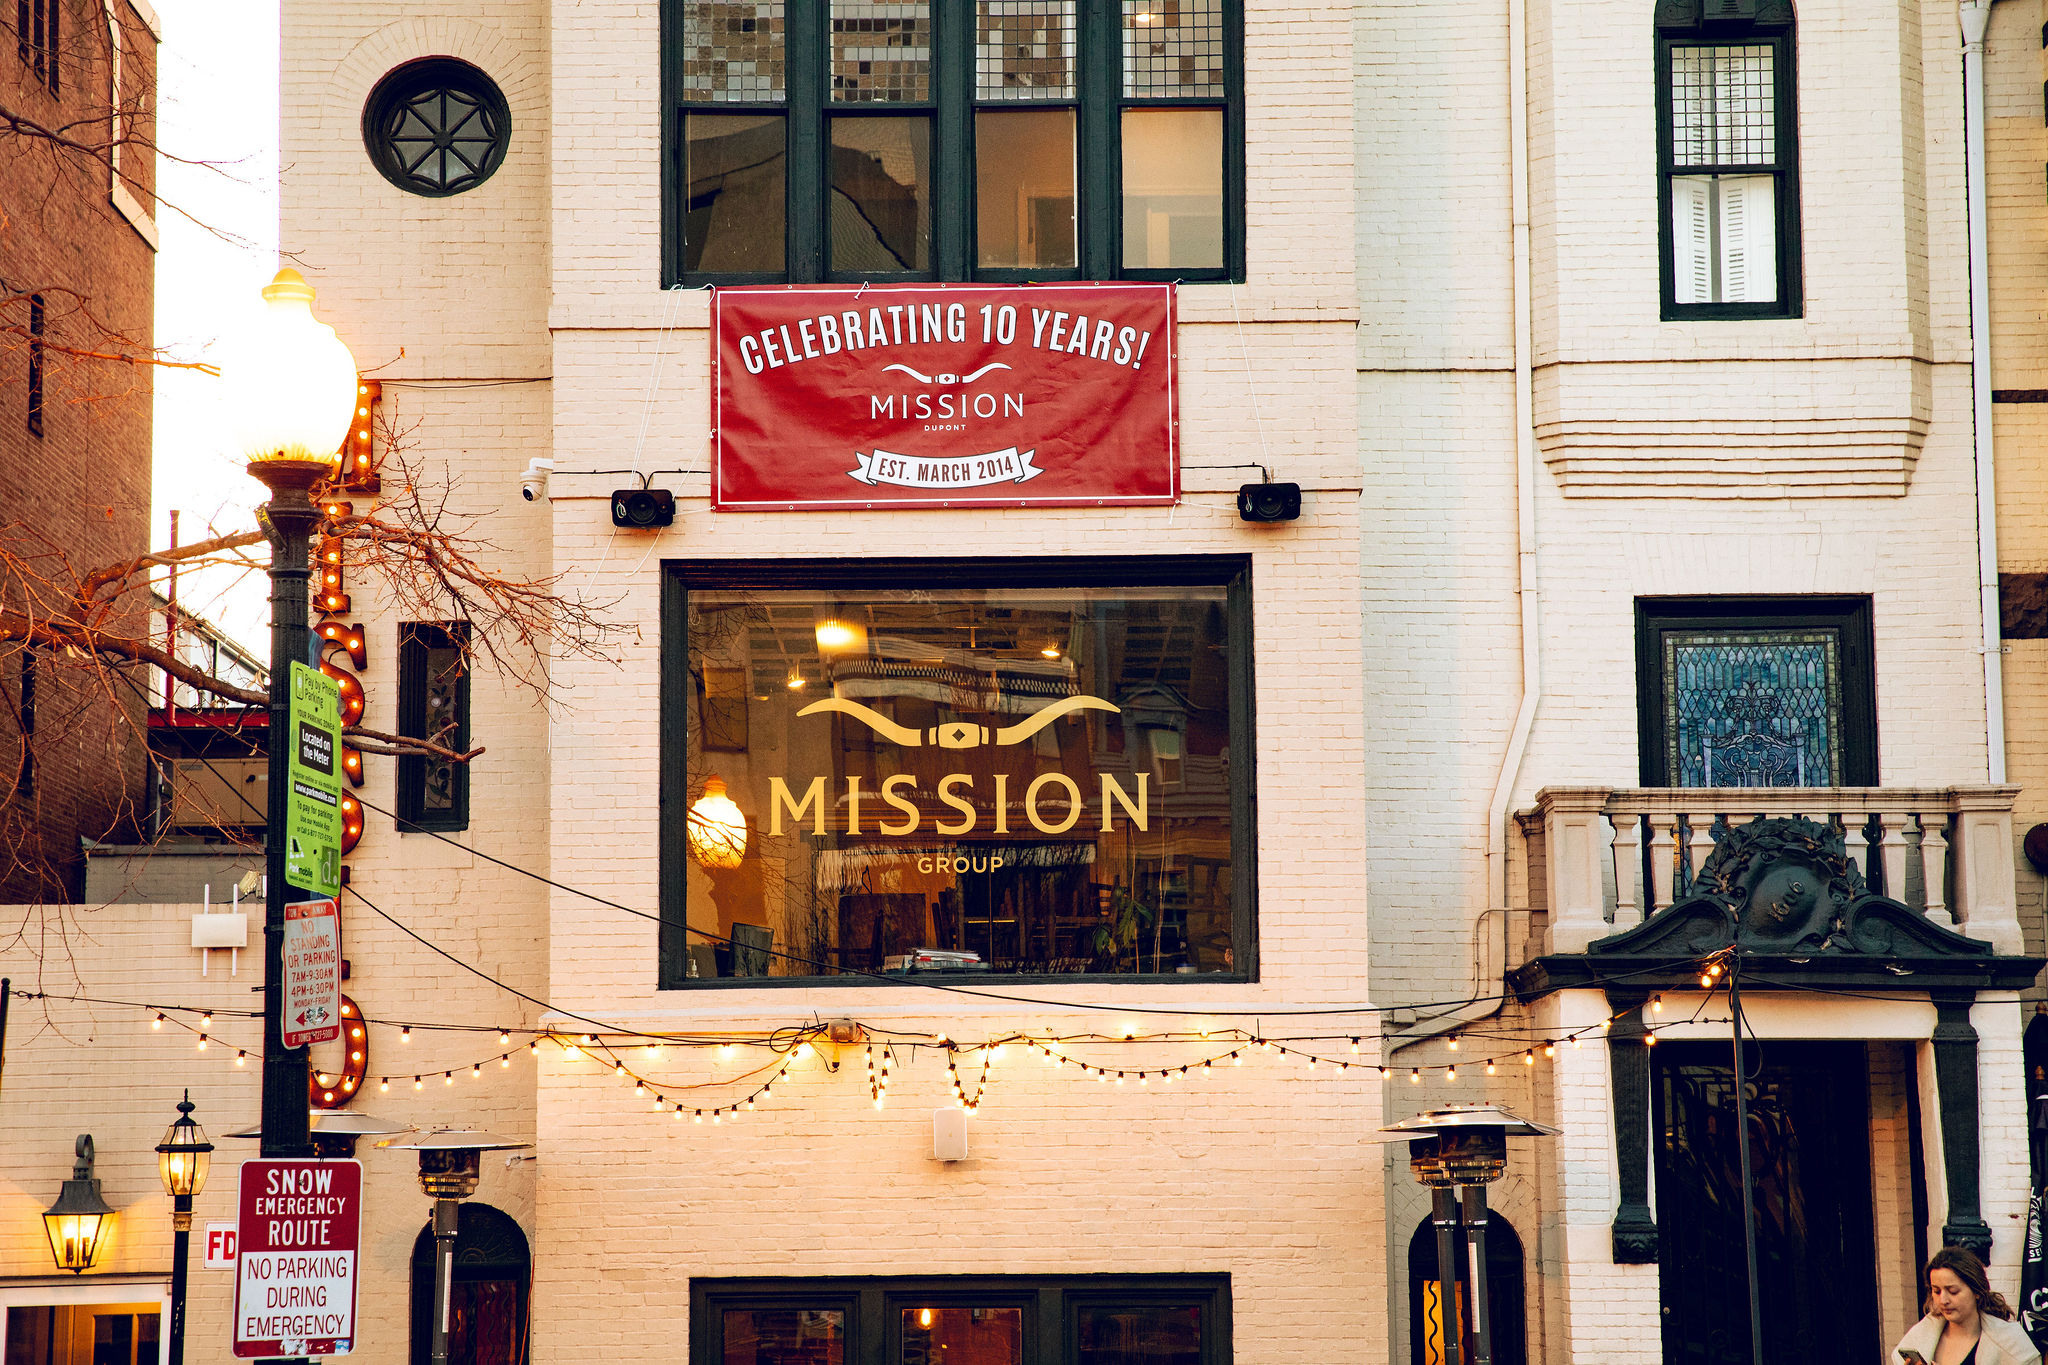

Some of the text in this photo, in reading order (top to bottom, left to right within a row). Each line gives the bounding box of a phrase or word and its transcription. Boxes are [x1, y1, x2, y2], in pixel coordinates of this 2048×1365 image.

[738, 302, 1152, 376] CELEBRATING 10 YEARS!
[870, 393, 1025, 420] MISSION
[924, 424, 967, 432] DUPONT
[878, 455, 1014, 483] EST. MARCH 2014
[304, 673, 338, 699] Pay by Phone
[304, 688, 324, 709] Parking
[308, 712, 323, 726] PARKING
[302, 728, 331, 752] Located on
[303, 745, 330, 767] the Meter
[295, 783, 336, 805] www.parkmobile.com
[767, 772, 1151, 837] MISSION
[297, 800, 302, 810] To
[303, 803, 311, 815] pay
[289, 861, 313, 878] Parkmobile
[917, 856, 1004, 874] GROUP
[288, 904, 327, 918] TOW AWAY
[301, 920, 315, 935] NO
[290, 934, 330, 952] STANDING
[288, 950, 336, 968] OR PARKING
[266, 1168, 333, 1195] SNOW
[255, 1197, 347, 1216] EMERGENCY
[268, 1220, 331, 1246] ROUTE
[247, 1256, 347, 1280] NO PARKING
[267, 1285, 327, 1309] DURING
[246, 1314, 345, 1337] EMERGENCY
